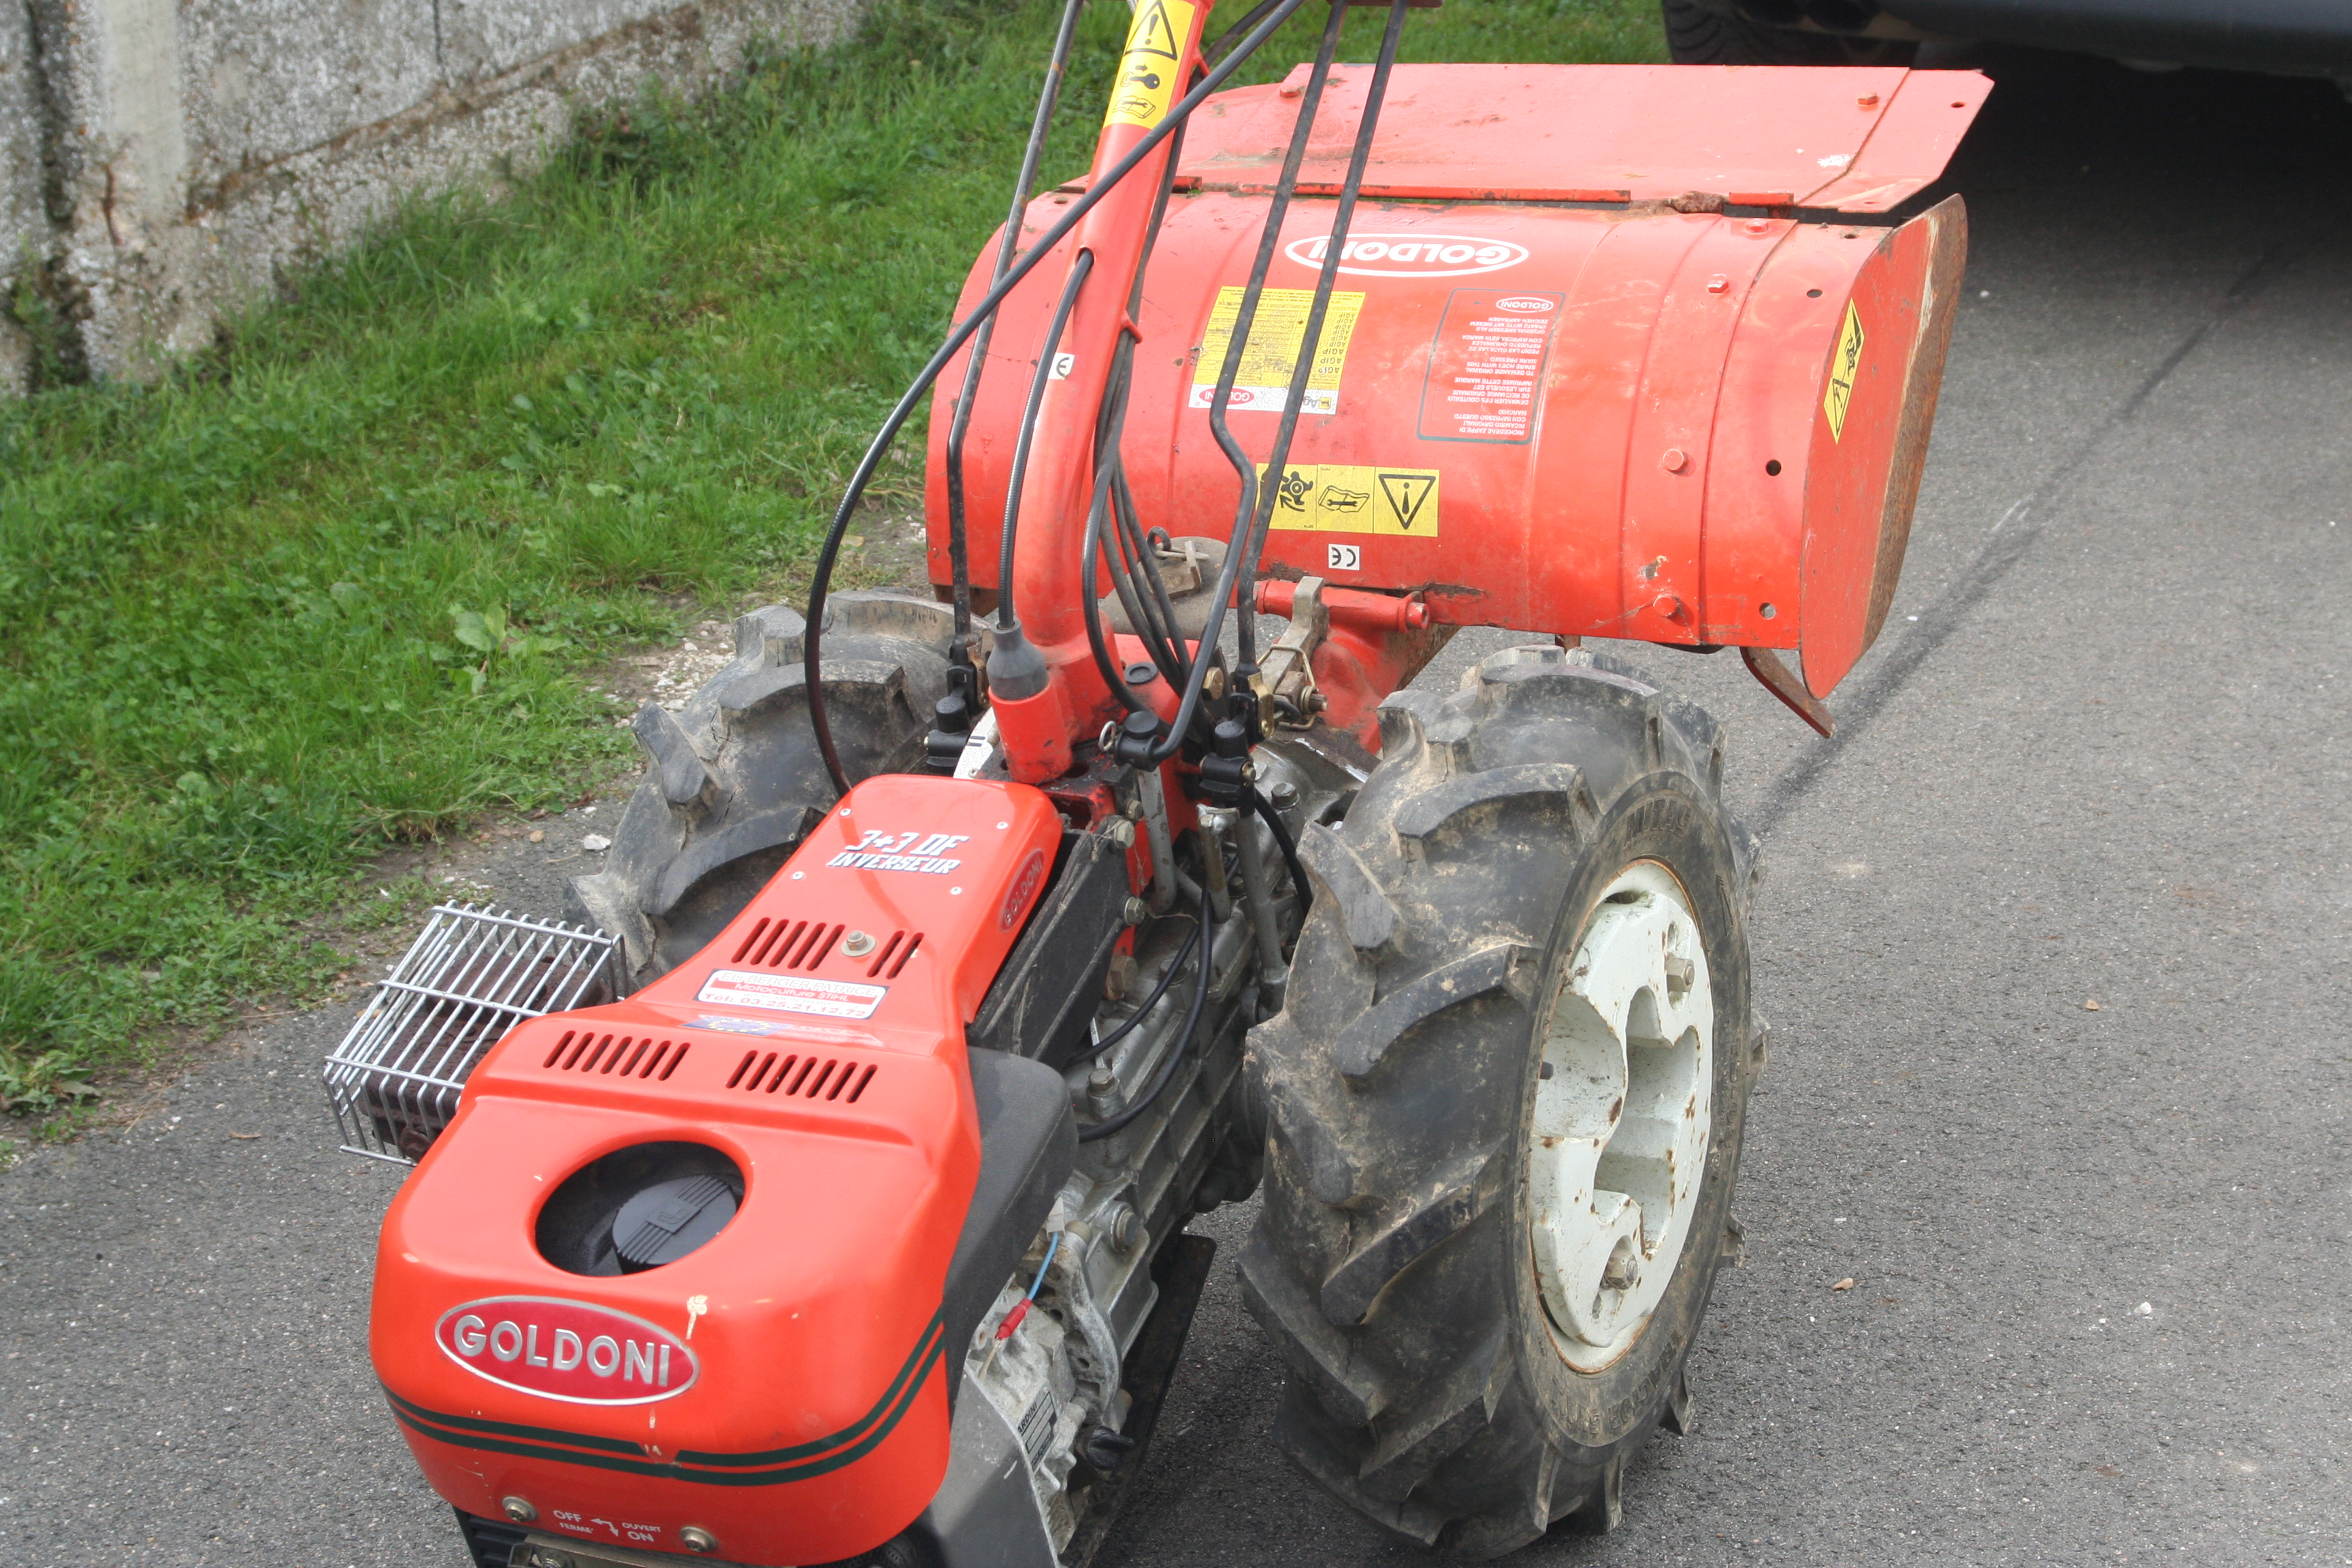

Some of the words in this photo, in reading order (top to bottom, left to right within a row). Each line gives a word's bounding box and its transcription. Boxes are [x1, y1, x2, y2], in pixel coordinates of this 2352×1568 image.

[1308, 240, 1511, 265] GOLDONI
[1203, 391, 1250, 401] GOLNI
[845, 830, 919, 853] 3+3
[910, 834, 969, 856] DF
[826, 852, 961, 874] INVERSEUR
[1003, 855, 1042, 927] GOLDONI
[721, 972, 744, 981] Ets
[747, 975, 811, 990] BERGER
[813, 982, 877, 996] PATRICE
[734, 983, 815, 998] Motoculture
[817, 992, 849, 1002] STIHL
[740, 998, 866, 1017] 03.25.21.12.72
[453, 1314, 672, 1387] GOLDONI
[553, 1509, 582, 1522] OFF
[621, 1522, 662, 1533] OUVERT
[627, 1531, 655, 1542] ON
